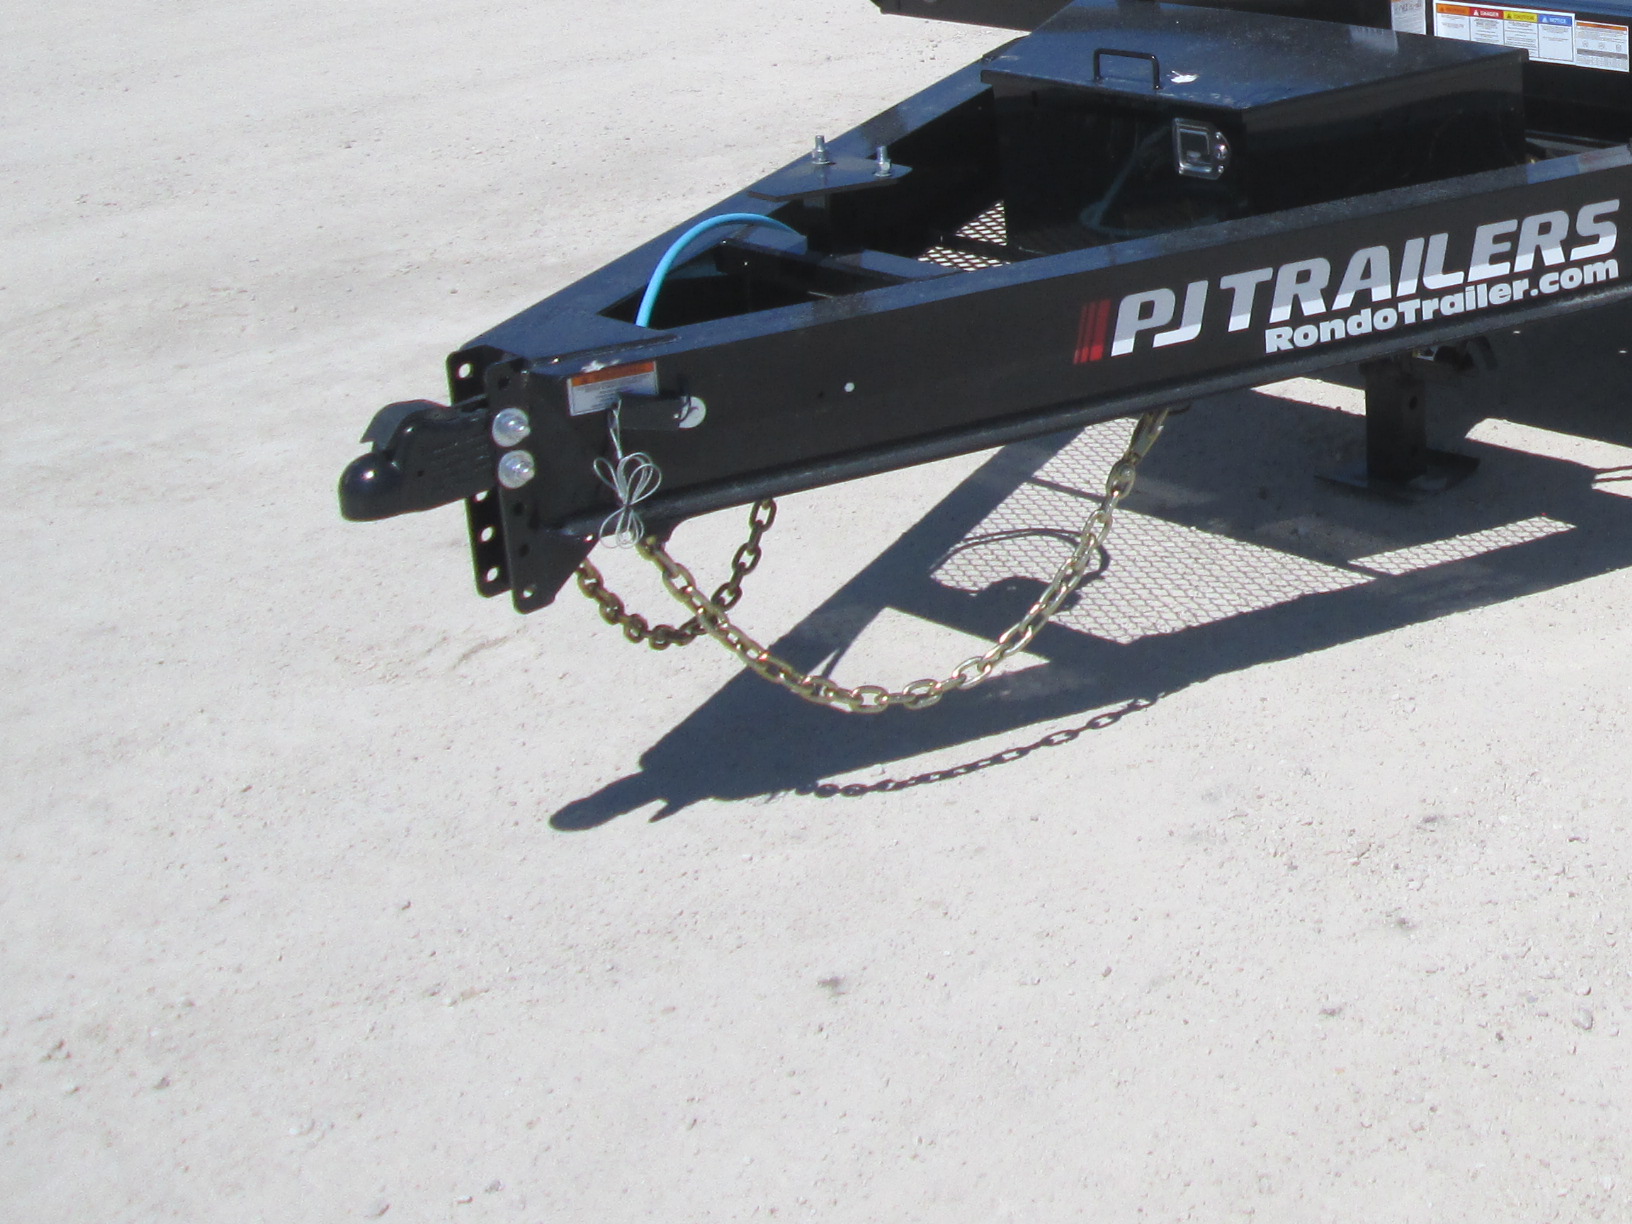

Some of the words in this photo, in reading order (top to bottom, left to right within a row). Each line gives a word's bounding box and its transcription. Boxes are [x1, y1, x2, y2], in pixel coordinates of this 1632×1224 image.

[1111, 280, 1208, 356] PJ
[1220, 199, 1620, 332] TRAILERS
[1265, 258, 1619, 353] RondoTrailer.com
